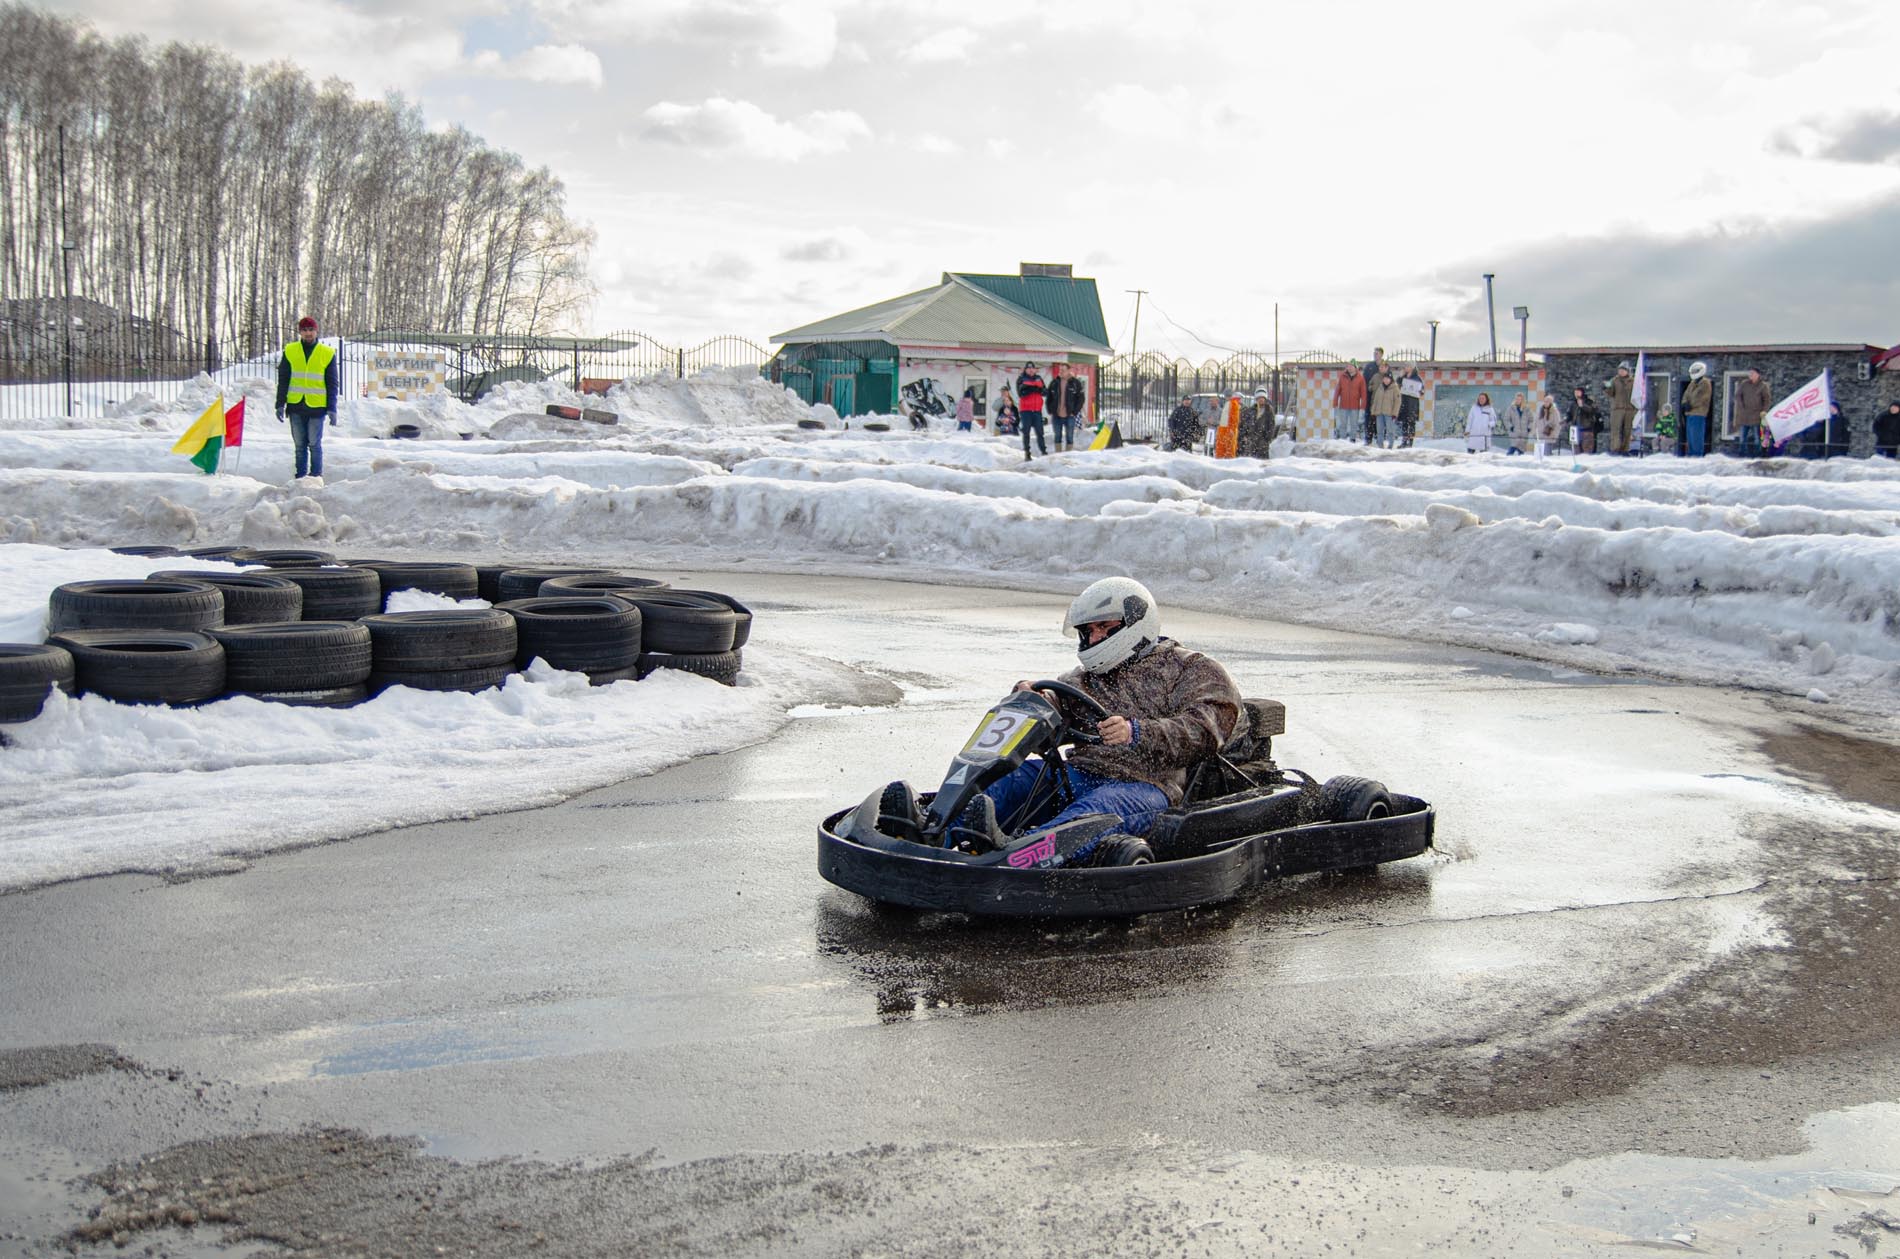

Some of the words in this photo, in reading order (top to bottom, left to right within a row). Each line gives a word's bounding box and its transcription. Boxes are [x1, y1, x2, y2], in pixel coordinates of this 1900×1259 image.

[374, 357, 438, 370] КАРТИНГ
[383, 376, 430, 389] ЦЕНТР
[977, 716, 1017, 748] 3
